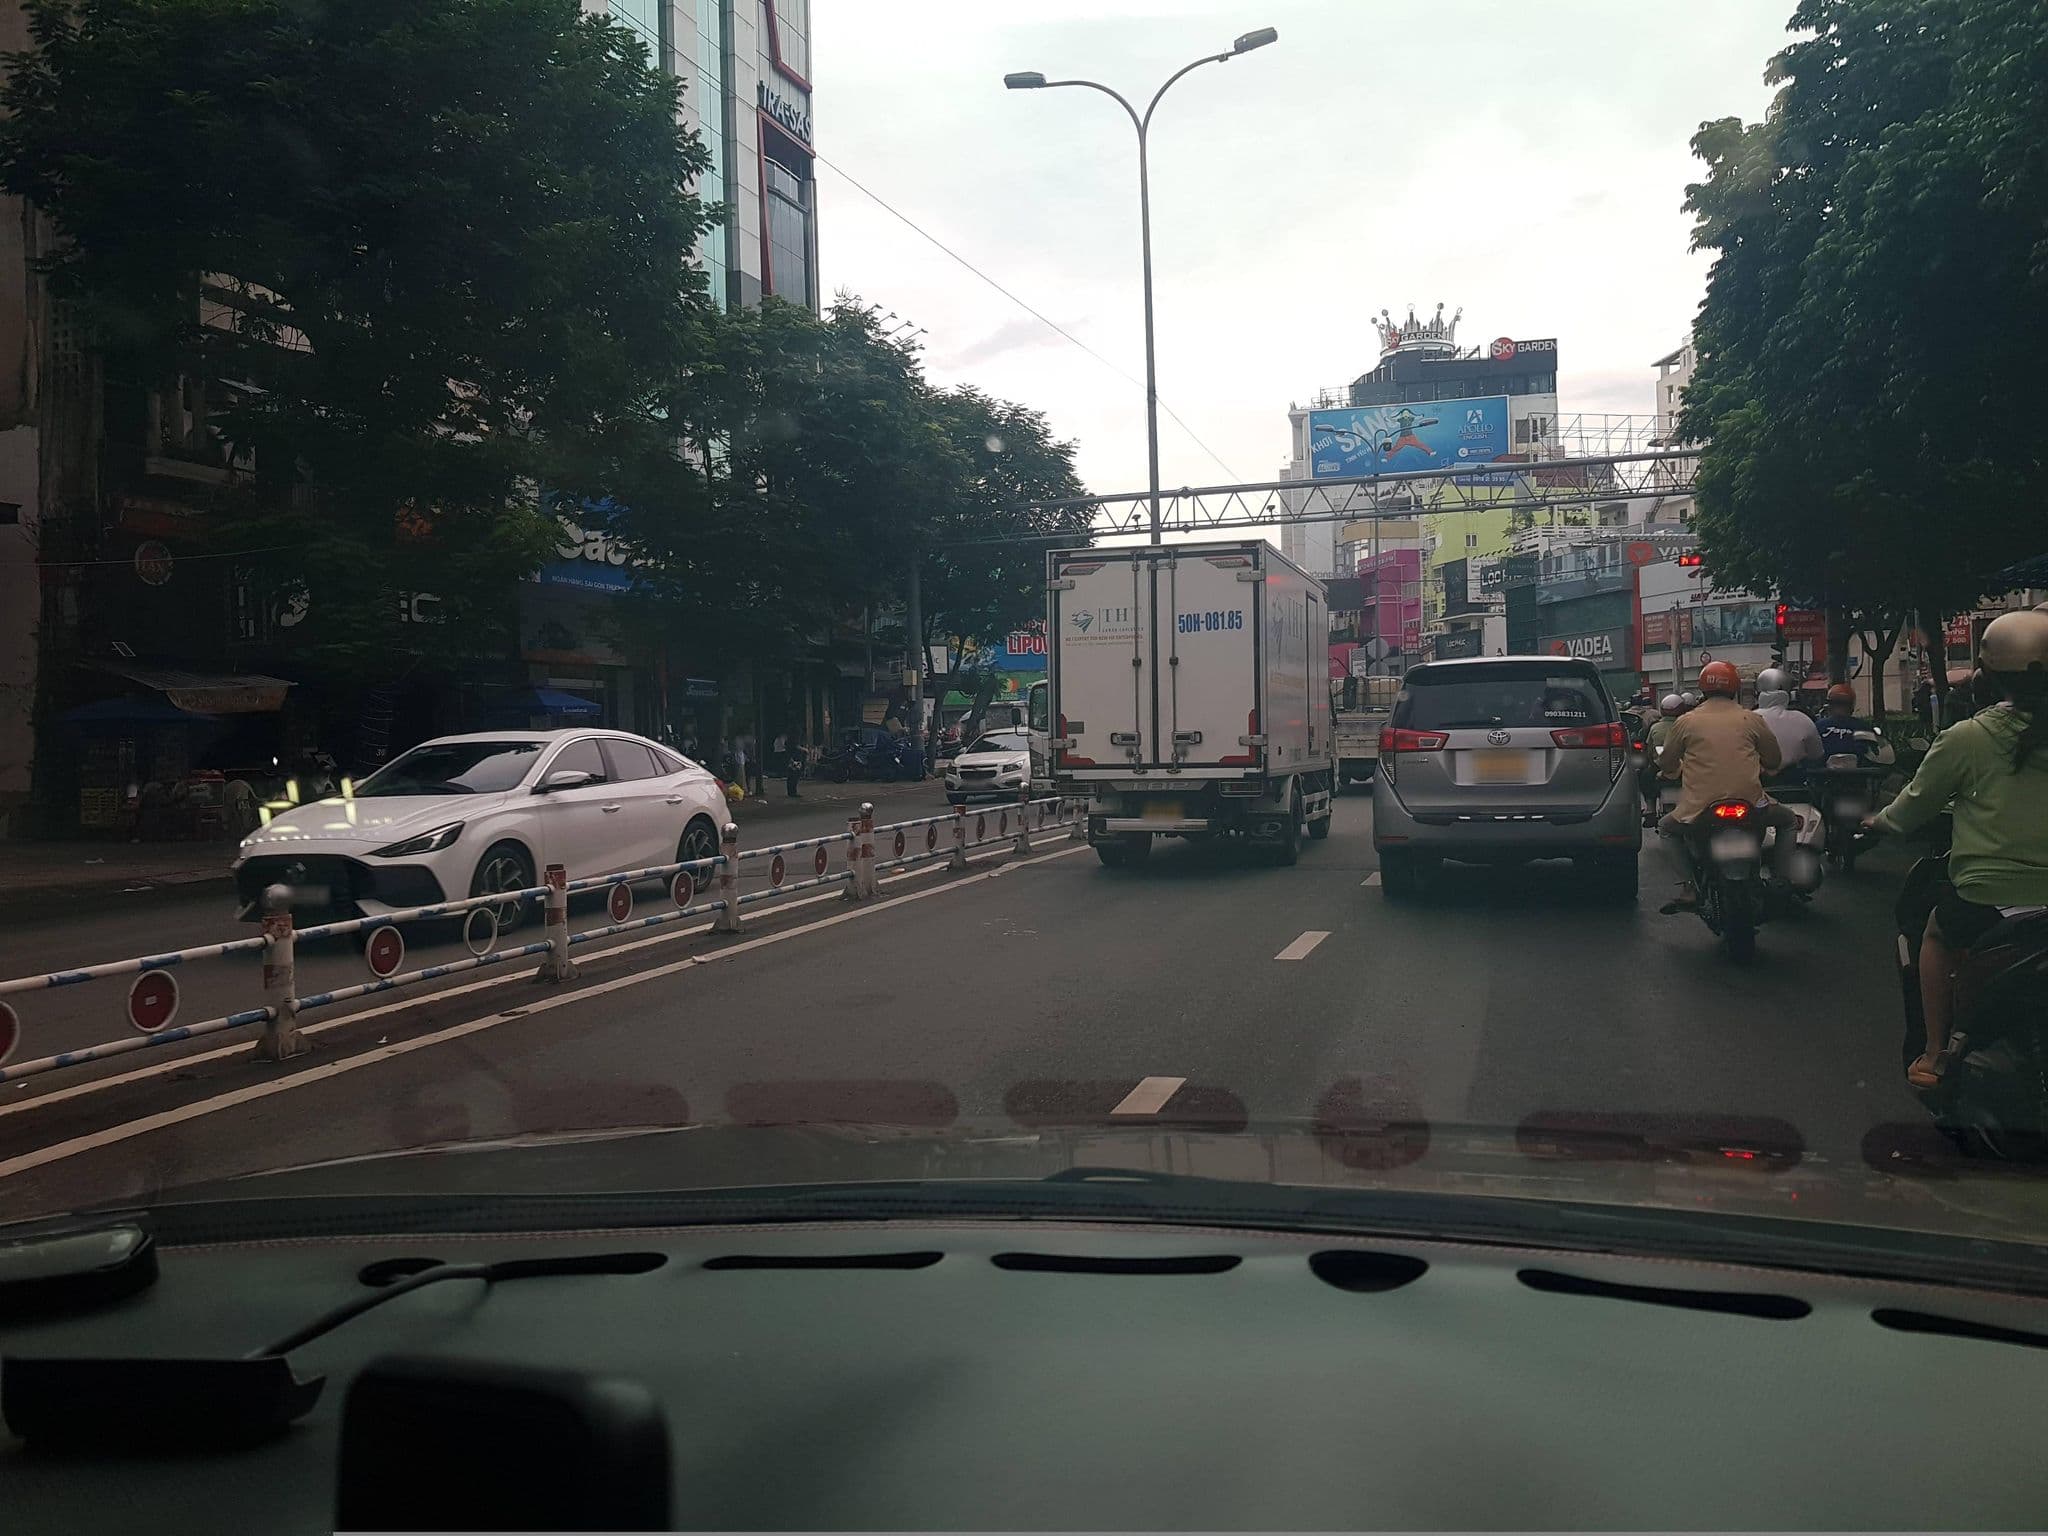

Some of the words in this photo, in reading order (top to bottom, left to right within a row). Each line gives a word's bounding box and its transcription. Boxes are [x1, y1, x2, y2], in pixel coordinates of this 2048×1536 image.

[1401, 331, 1444, 341] GARDEN
[1492, 343, 1515, 356] SKY
[1517, 341, 1557, 352] GARDEN
[1458, 423, 1495, 434] APOLLO
[1178, 610, 1242, 633] 50H-081.85
[1567, 635, 1612, 657] YADEA
[1821, 726, 1853, 740] Japa
